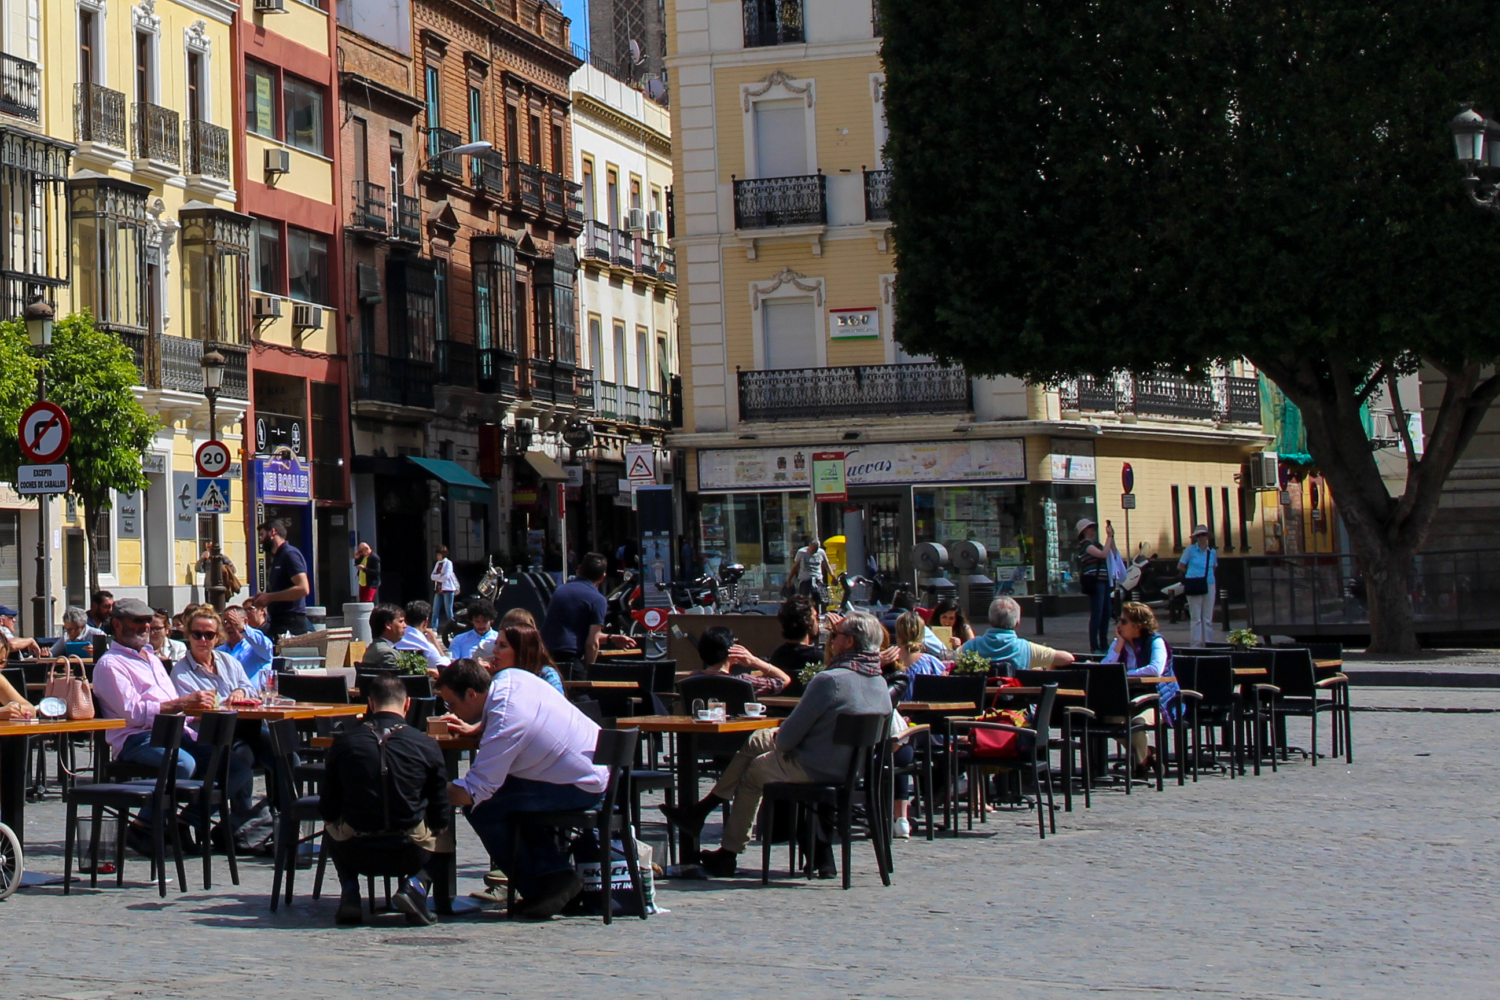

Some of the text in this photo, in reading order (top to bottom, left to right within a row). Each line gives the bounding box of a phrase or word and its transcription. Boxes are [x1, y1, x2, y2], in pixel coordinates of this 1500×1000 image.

[203, 452, 224, 465] 20
[33, 469, 52, 477] EXCEPTO
[20, 479, 66, 489] COCHES DE CABALLOS
[263, 472, 308, 493] NES ROSALES
